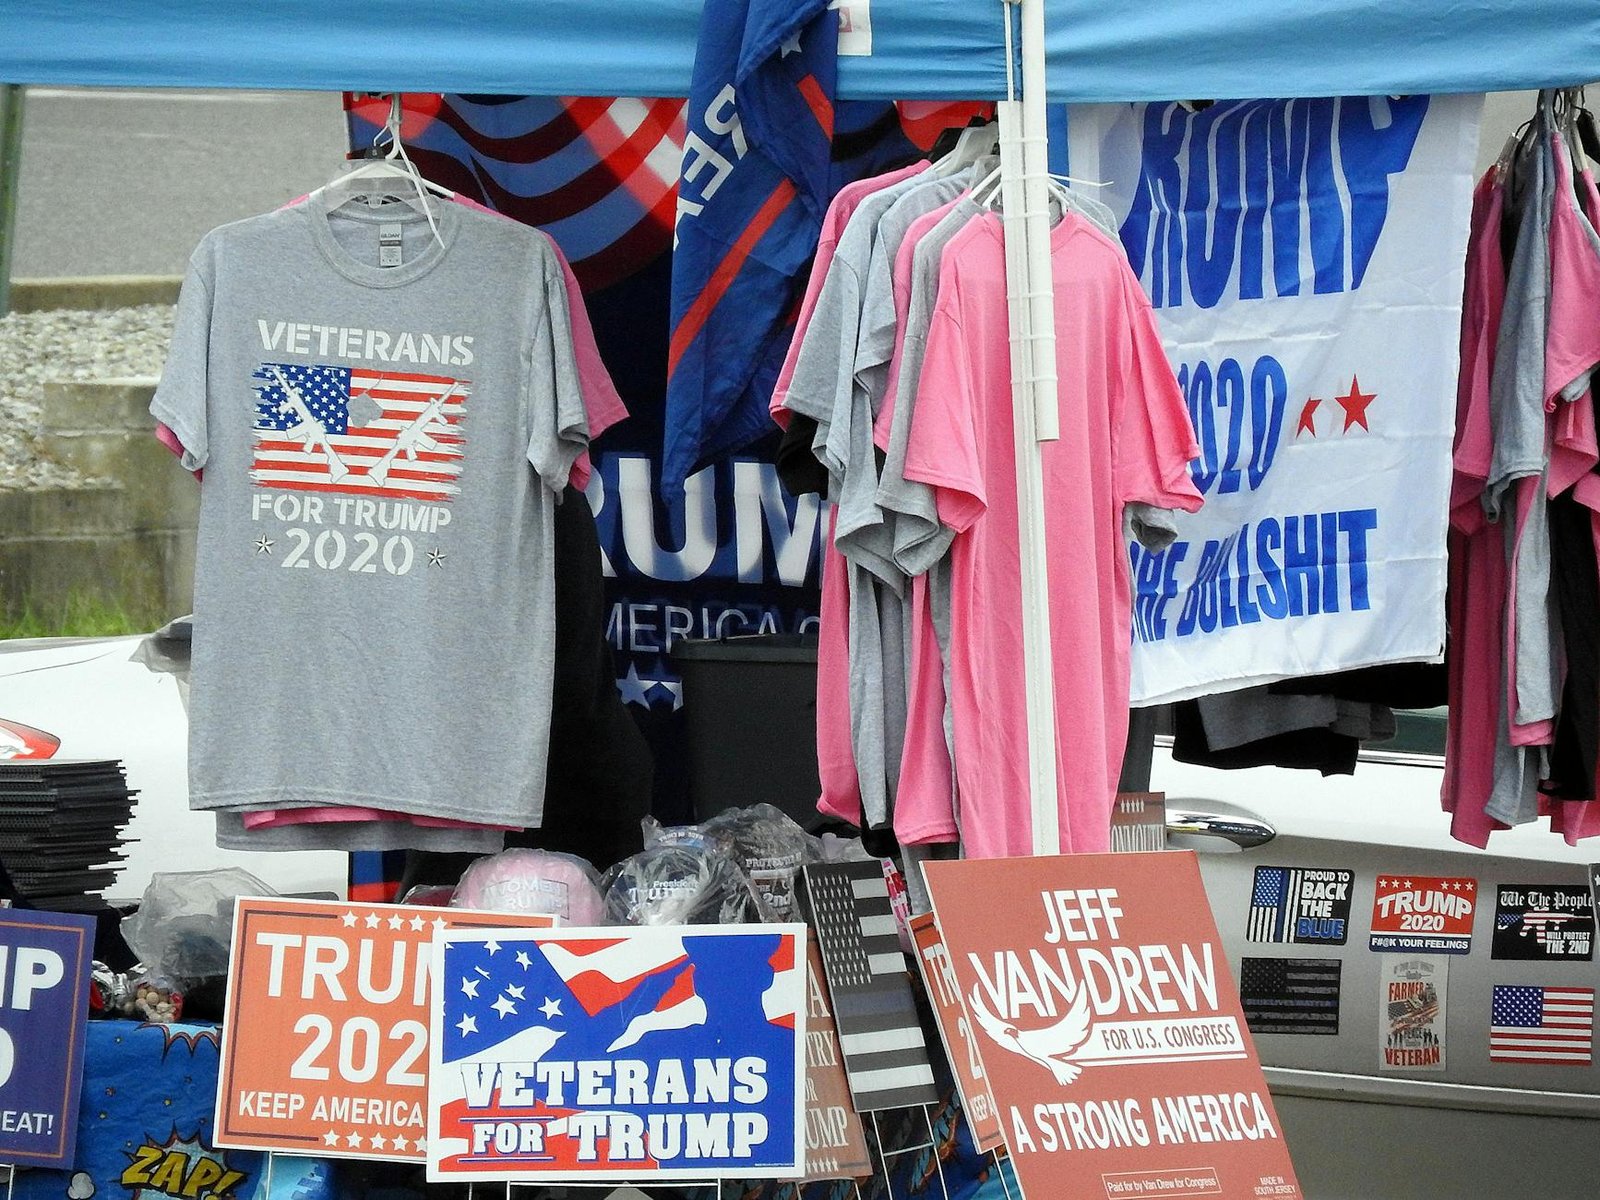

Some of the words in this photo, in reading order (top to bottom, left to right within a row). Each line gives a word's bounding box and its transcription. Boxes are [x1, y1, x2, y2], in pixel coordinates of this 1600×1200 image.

[1118, 96, 1430, 309] RUMP
[257, 319, 474, 366] VETERANS
[1178, 354, 1287, 496] 020
[252, 494, 324, 524] FOR
[334, 498, 452, 533] TRUMP
[281, 528, 414, 576] 2020
[1176, 508, 1377, 637] BULLSHIT
[1302, 881, 1349, 900] BACK
[1304, 870, 1335, 882] PROUD
[1338, 871, 1350, 882] TO
[1301, 900, 1333, 918] THE
[1377, 890, 1472, 919] TRUMP
[1500, 891, 1525, 907] We
[1528, 891, 1551, 907] The
[1040, 888, 1124, 943] JEFF
[1297, 917, 1346, 939] BLUE
[1400, 914, 1445, 931] 2020
[1398, 939, 1424, 948] YOUR
[1424, 939, 1469, 949] FEELINGS
[1546, 941, 1565, 954] THE
[1568, 940, 1590, 954] 2ND
[1563, 932, 1591, 940] PROTECT
[1101, 1027, 1131, 1051] FOR
[1135, 1026, 1162, 1050] U.S.
[1164, 1022, 1236, 1048] CONGRESS
[1385, 1046, 1440, 1067] VETERAN
[460, 1056, 769, 1107] VETERANS
[2, 1110, 54, 1136] EAT!
[239, 1090, 305, 1120] KEEP
[311, 1096, 424, 1129] AMERICA
[1010, 1105, 1037, 1154] A
[1033, 1097, 1151, 1153] STRONG
[1150, 1091, 1278, 1146] AMERICA
[473, 1121, 546, 1155] FOR
[567, 1112, 769, 1161] TRUMP
[120, 1145, 245, 1200] ZAP!
[1107, 1181, 1124, 1193] Paid
[1124, 1180, 1133, 1191] for
[1133, 1181, 1143, 1193] by
[1142, 1179, 1157, 1190] Van
[1157, 1178, 1175, 1190] Drew
[1184, 1177, 1217, 1189] Congress
